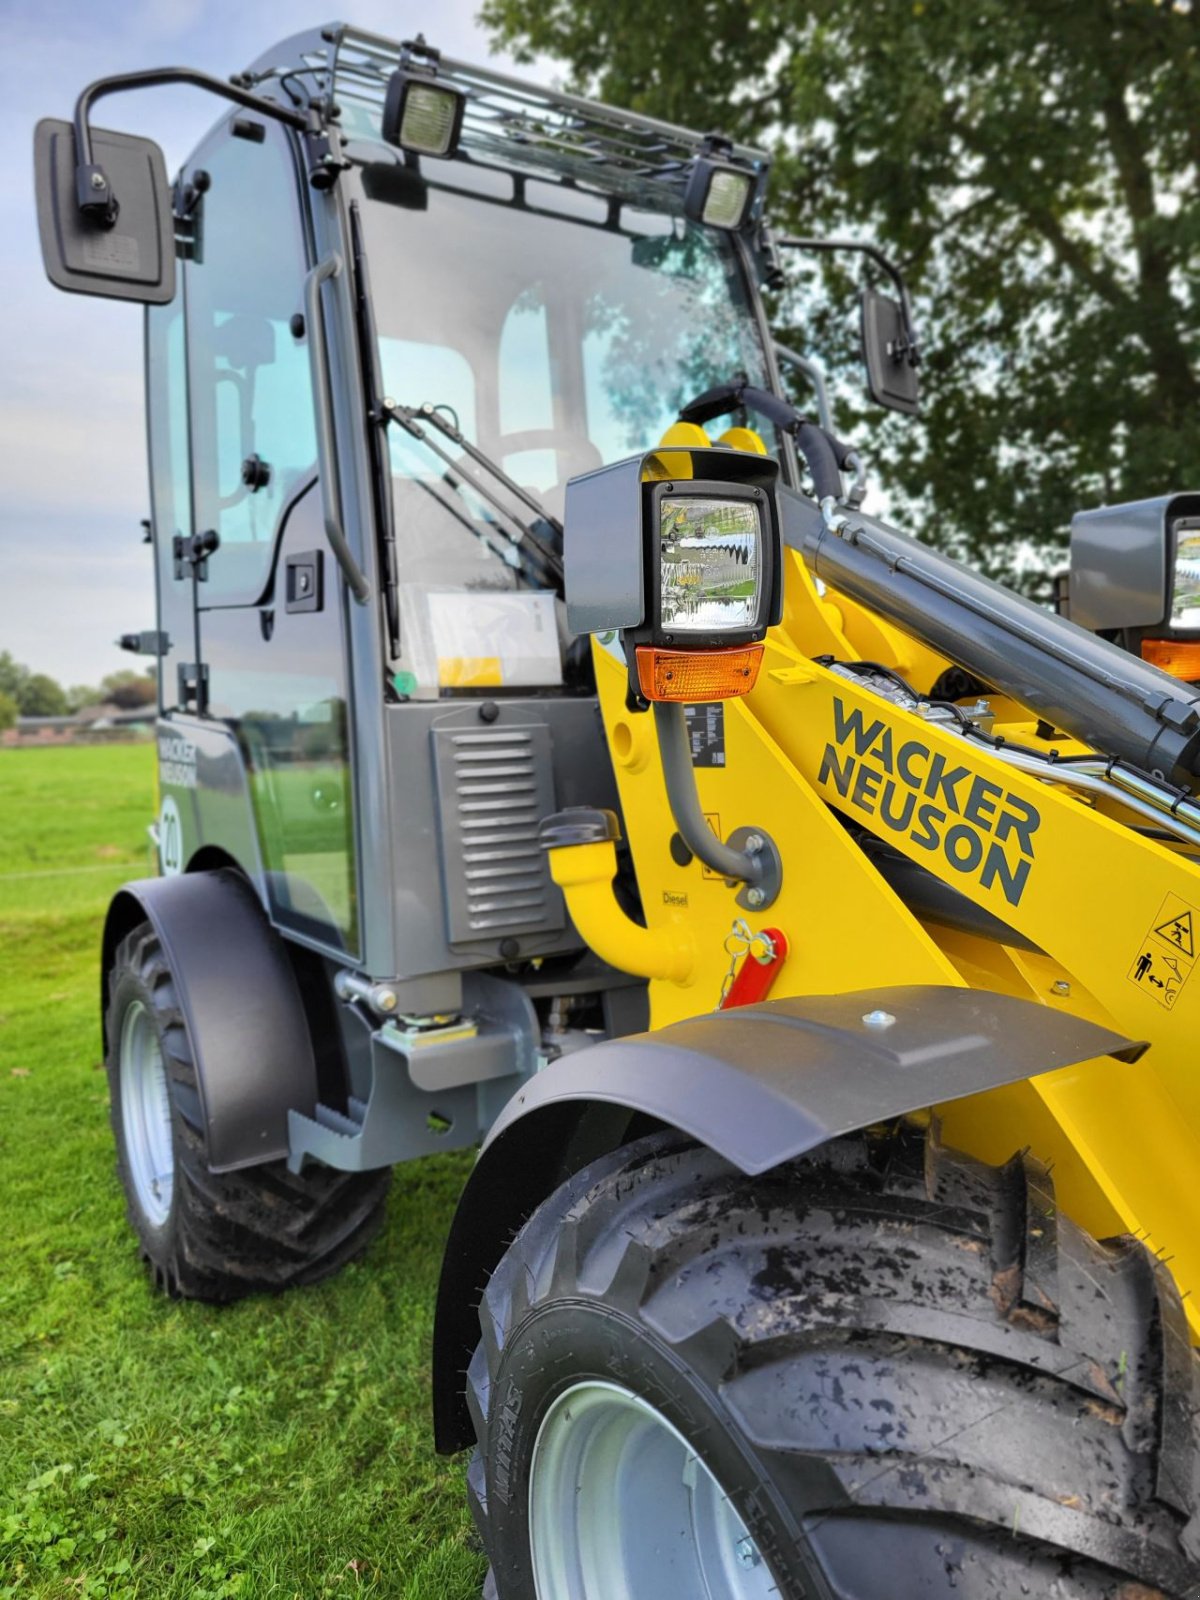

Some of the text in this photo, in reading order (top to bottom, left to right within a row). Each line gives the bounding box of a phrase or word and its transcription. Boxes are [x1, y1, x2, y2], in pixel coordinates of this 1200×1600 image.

[159, 737, 196, 762] WACKER
[160, 762, 196, 788] NEUSON
[833, 696, 1041, 859] WACKER
[818, 743, 1032, 907] NEUSON
[662, 891, 688, 907] Diesel
